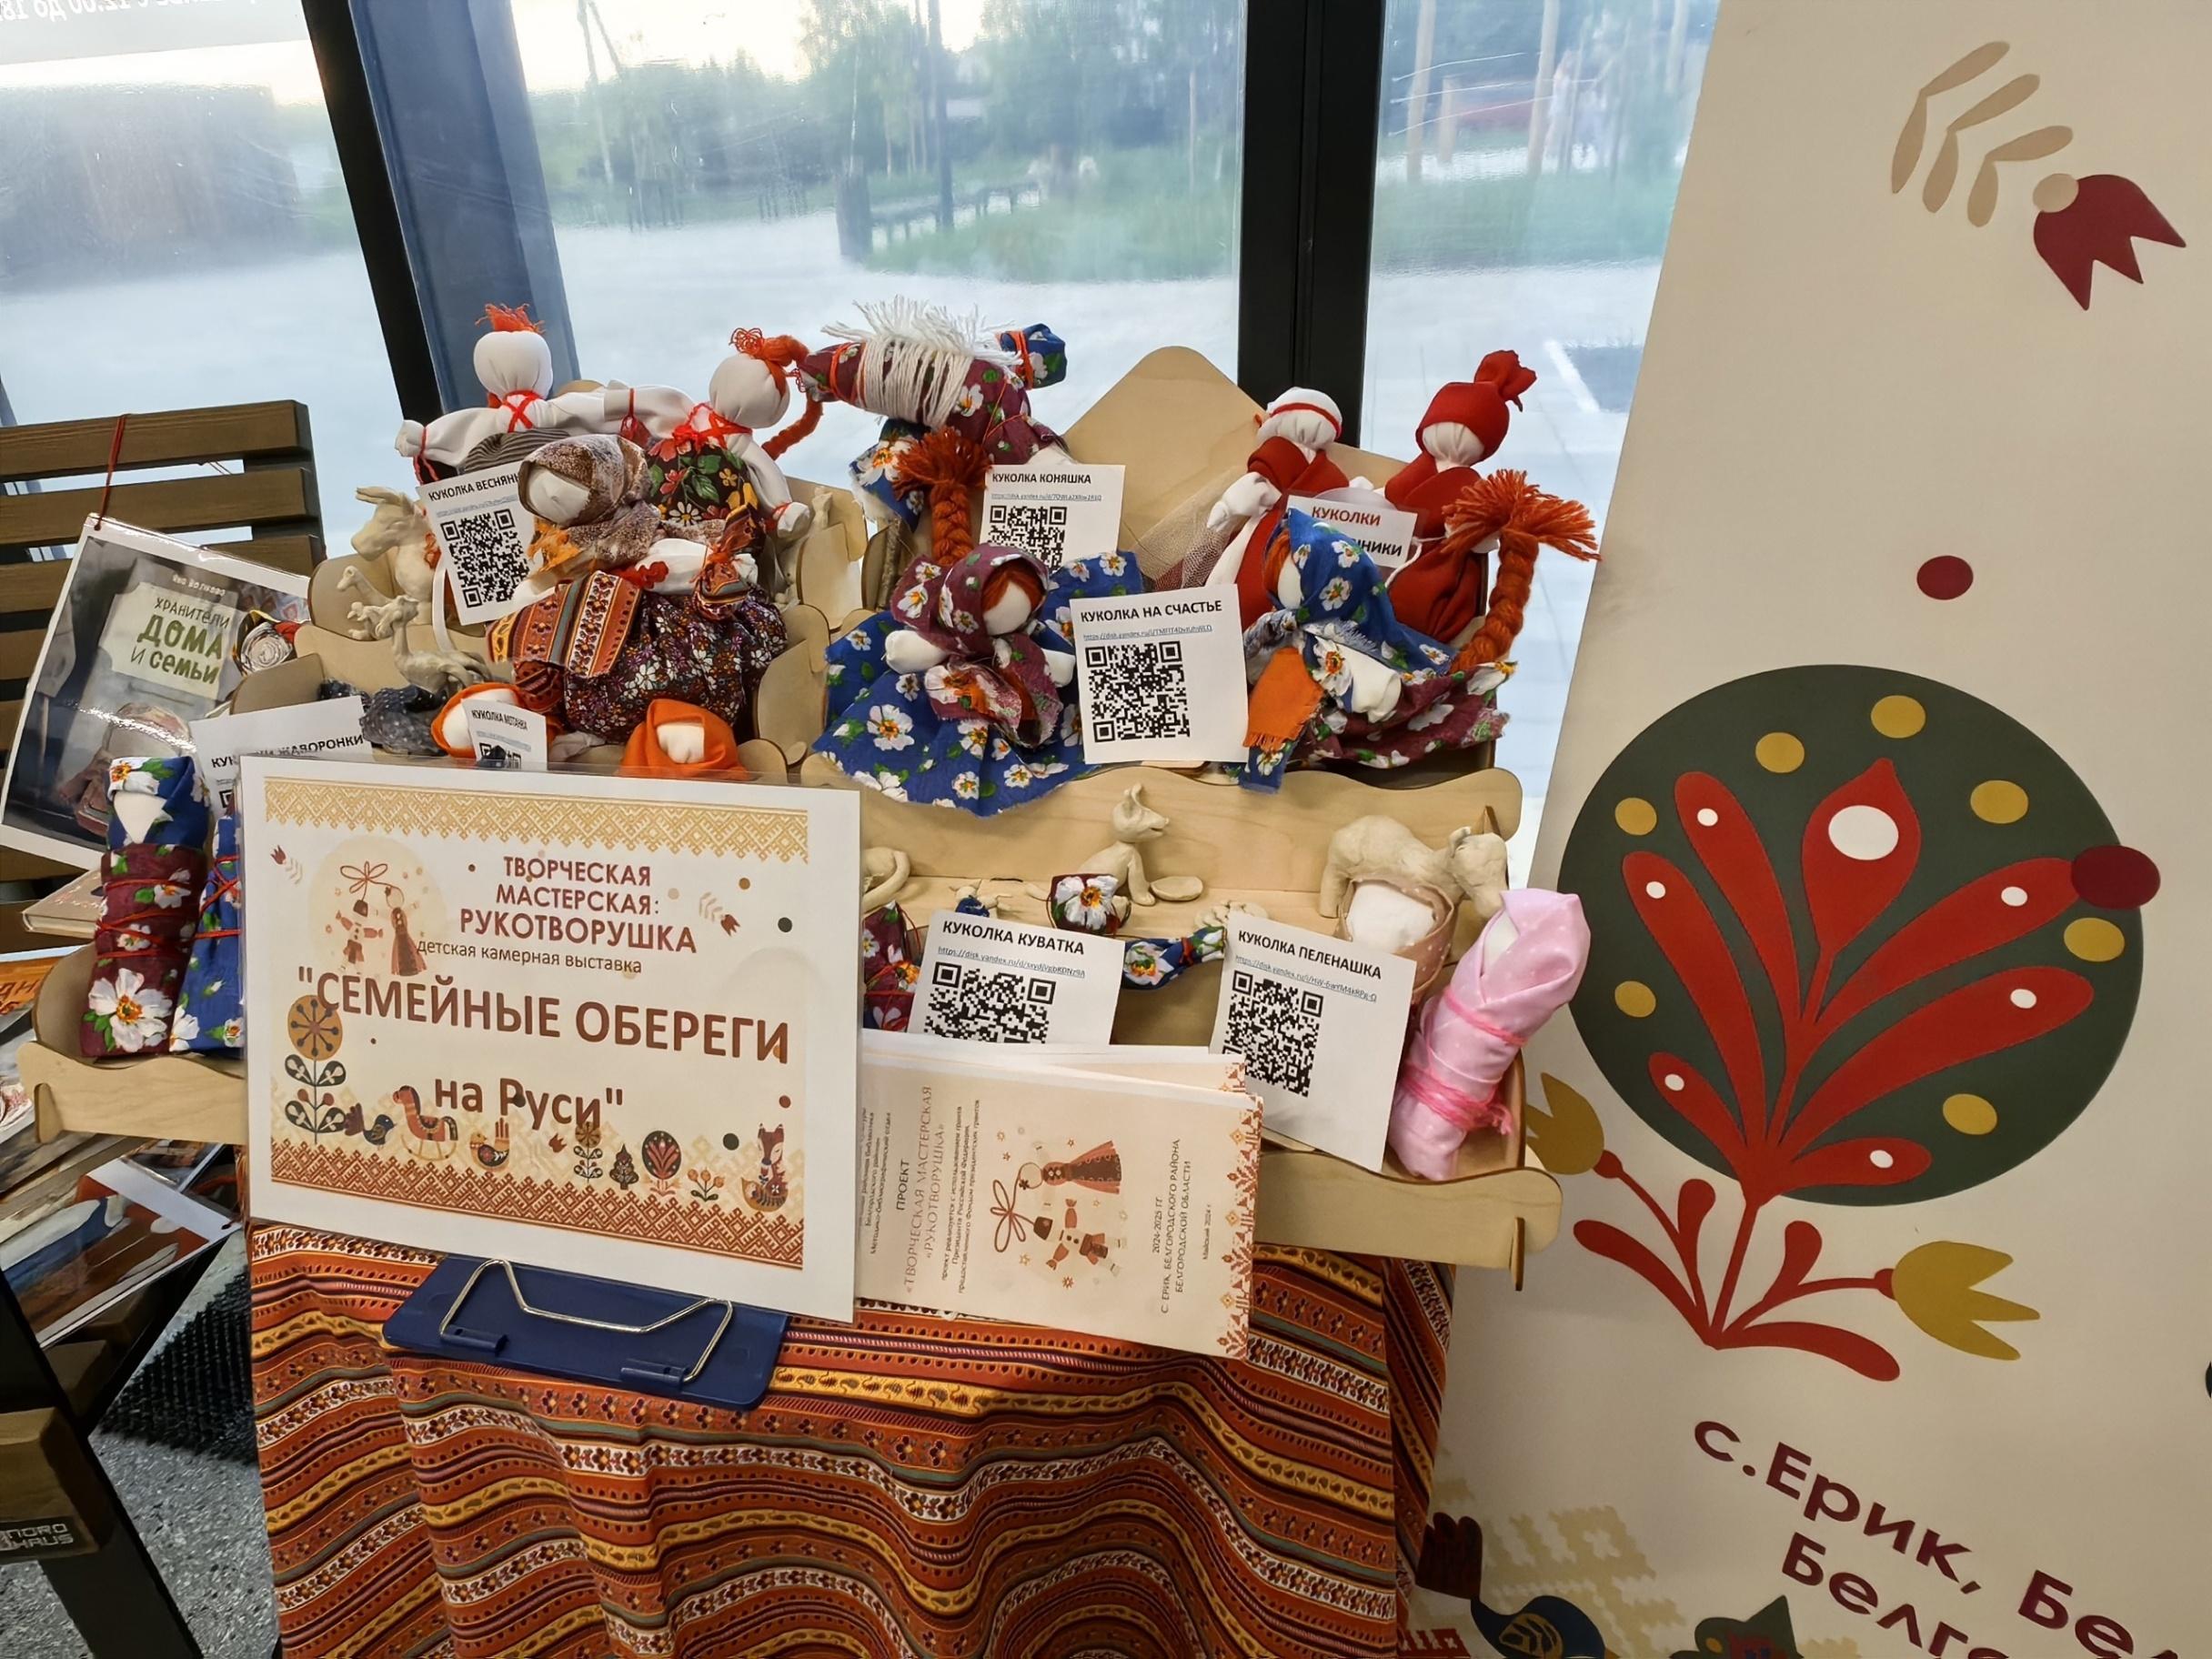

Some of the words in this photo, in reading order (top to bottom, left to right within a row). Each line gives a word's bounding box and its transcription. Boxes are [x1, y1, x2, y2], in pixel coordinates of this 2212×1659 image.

[428, 483, 475, 501] КУКОЛКА
[992, 473, 1037, 484] КУКОЛКА
[1040, 474, 1091, 485] КОНЯШКА
[1312, 506, 1381, 527] КУКОЛКИ
[1081, 608, 1140, 623] КУКОЛКА
[1142, 606, 1162, 618] НА
[1165, 600, 1223, 617] СЧАСТЬЕ
[136, 614, 223, 660] ДОМА
[503, 856, 651, 887] ТВОРЧЕСКАЯ
[496, 883, 659, 915] МАСТЕРСКАЯ:
[460, 908, 697, 953] РУКОТВОРУШКА
[942, 920, 1013, 944] КУКОЛКА
[1018, 933, 1085, 955] КУВАТКА
[417, 940, 477, 958] детская
[481, 945, 560, 967] камерная
[565, 954, 642, 973] выставка
[1238, 930, 1297, 957] КУКОЛКА
[1298, 946, 1382, 980] ПЕЛЕНАШКА
[297, 966, 561, 1038] "СЕМЕЙНЫЕ
[575, 1000, 789, 1064] ОБЕРЕГИ
[434, 1078, 484, 1113] на
[498, 1078, 625, 1131] Руси"
[896, 1158, 910, 1211] ПРОЕКТ
[904, 1189, 925, 1293] «ТВОРЧЕСКАЯ
[917, 1086, 932, 1183] МАСТЕРСКАЯ
[923, 1123, 945, 1259] «РУКОТВОРУШКА»
[957, 1171, 967, 1215] Российской
[1152, 1211, 1162, 1253] 2024-2025
[1164, 1183, 1177, 1270] БЕЛГОРОДСКОГО
[1175, 1211, 1187, 1292] БЕЛГОРОДСКОЙ
[1181, 1161, 1191, 1209] ОБЛАСТИ
[1694, 1421, 1981, 1594] с.Ерик,
[2017, 1570, 2179, 1659] Бе
